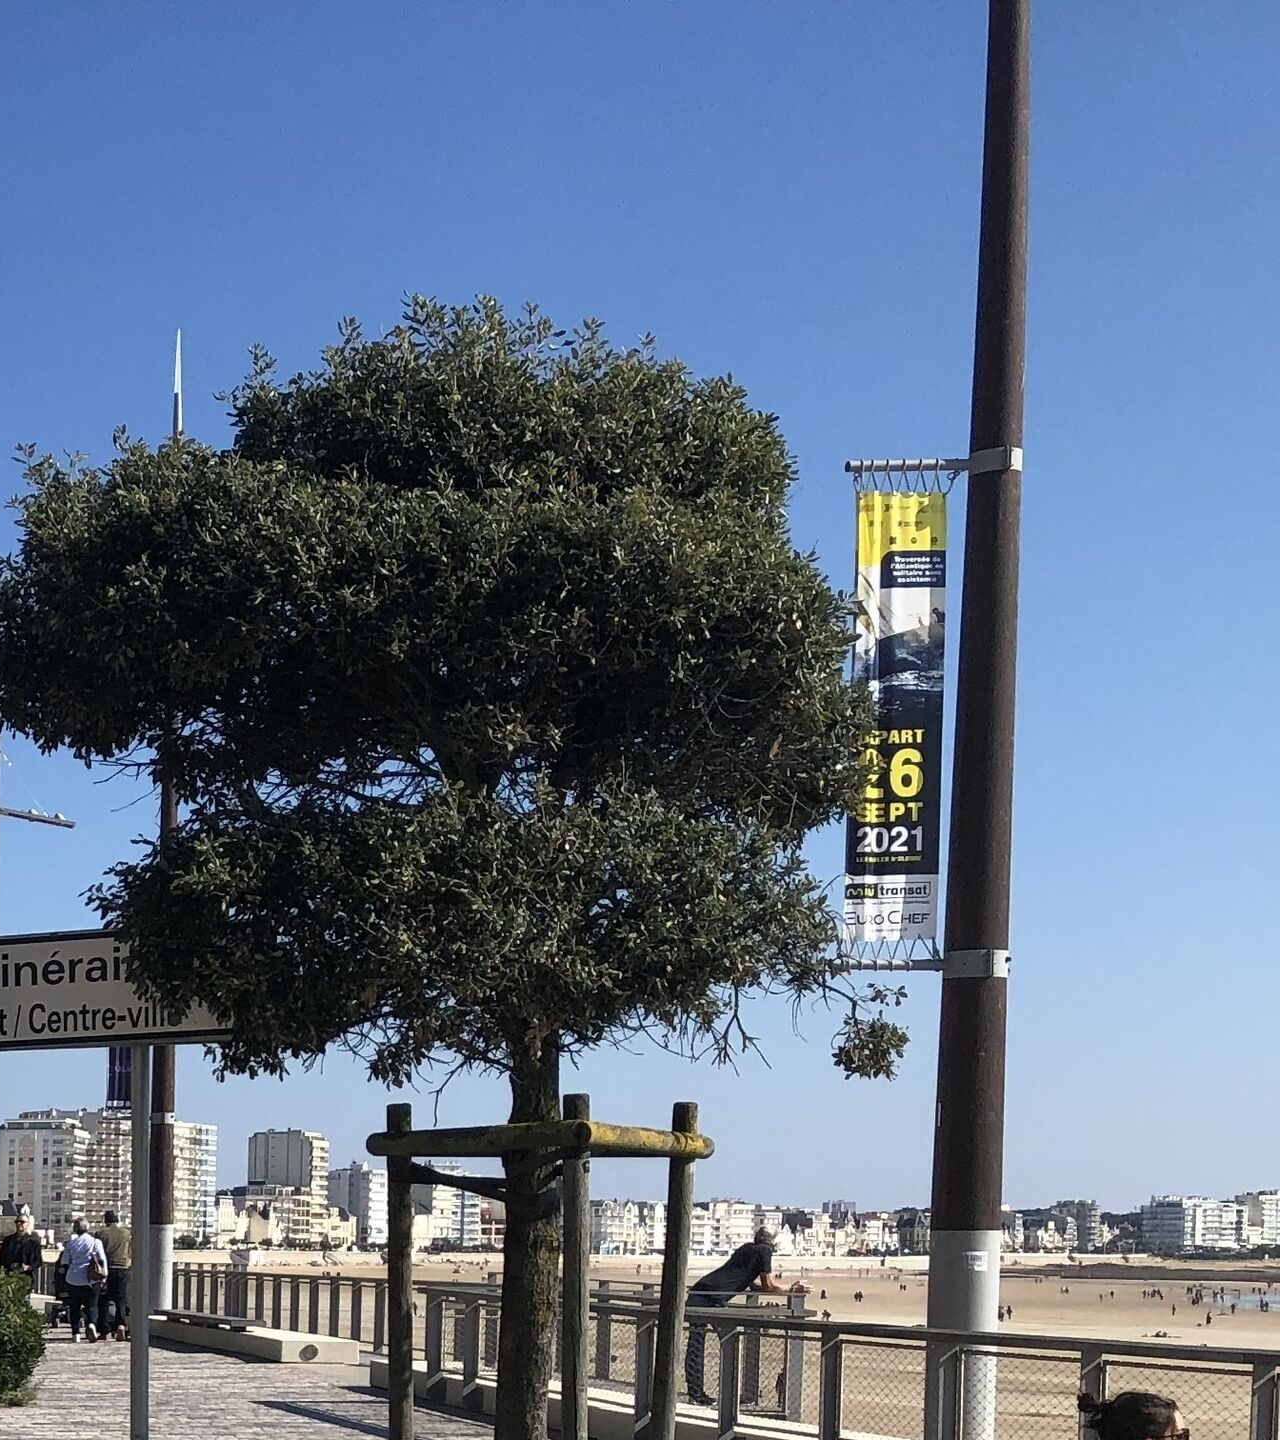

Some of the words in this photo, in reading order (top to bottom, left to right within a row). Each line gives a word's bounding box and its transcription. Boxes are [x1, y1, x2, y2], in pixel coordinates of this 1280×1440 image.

[859, 748, 924, 798] 26
[856, 802, 924, 823] SEPT
[856, 825, 924, 853] 2021
[880, 884, 927, 896] transat
[13, 1004, 22, 1039] /
